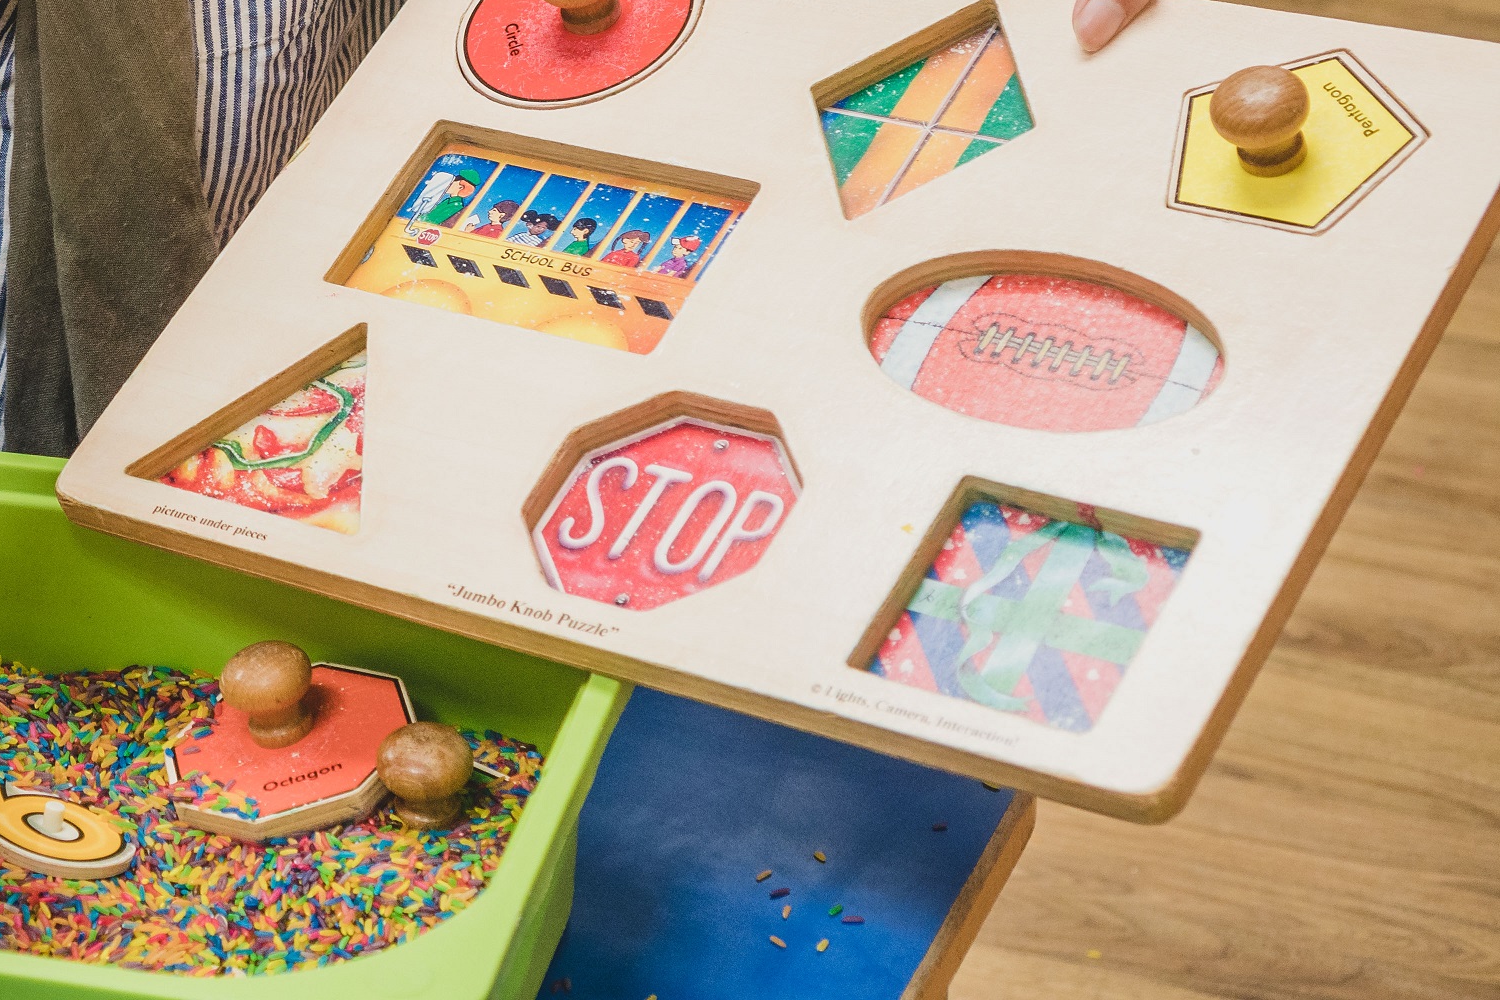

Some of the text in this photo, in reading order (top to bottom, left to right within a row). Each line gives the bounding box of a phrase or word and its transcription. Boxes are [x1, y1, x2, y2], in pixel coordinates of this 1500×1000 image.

[504, 23, 524, 56] Circle
[1322, 82, 1380, 137] Pentagon
[419, 231, 439, 243] STOP
[500, 248, 593, 277] SCHOOL BUS
[152, 504, 268, 541] pictures under pieces
[558, 457, 784, 583] STOP
[510, 600, 554, 622] Knob
[263, 763, 343, 791] Octagon
